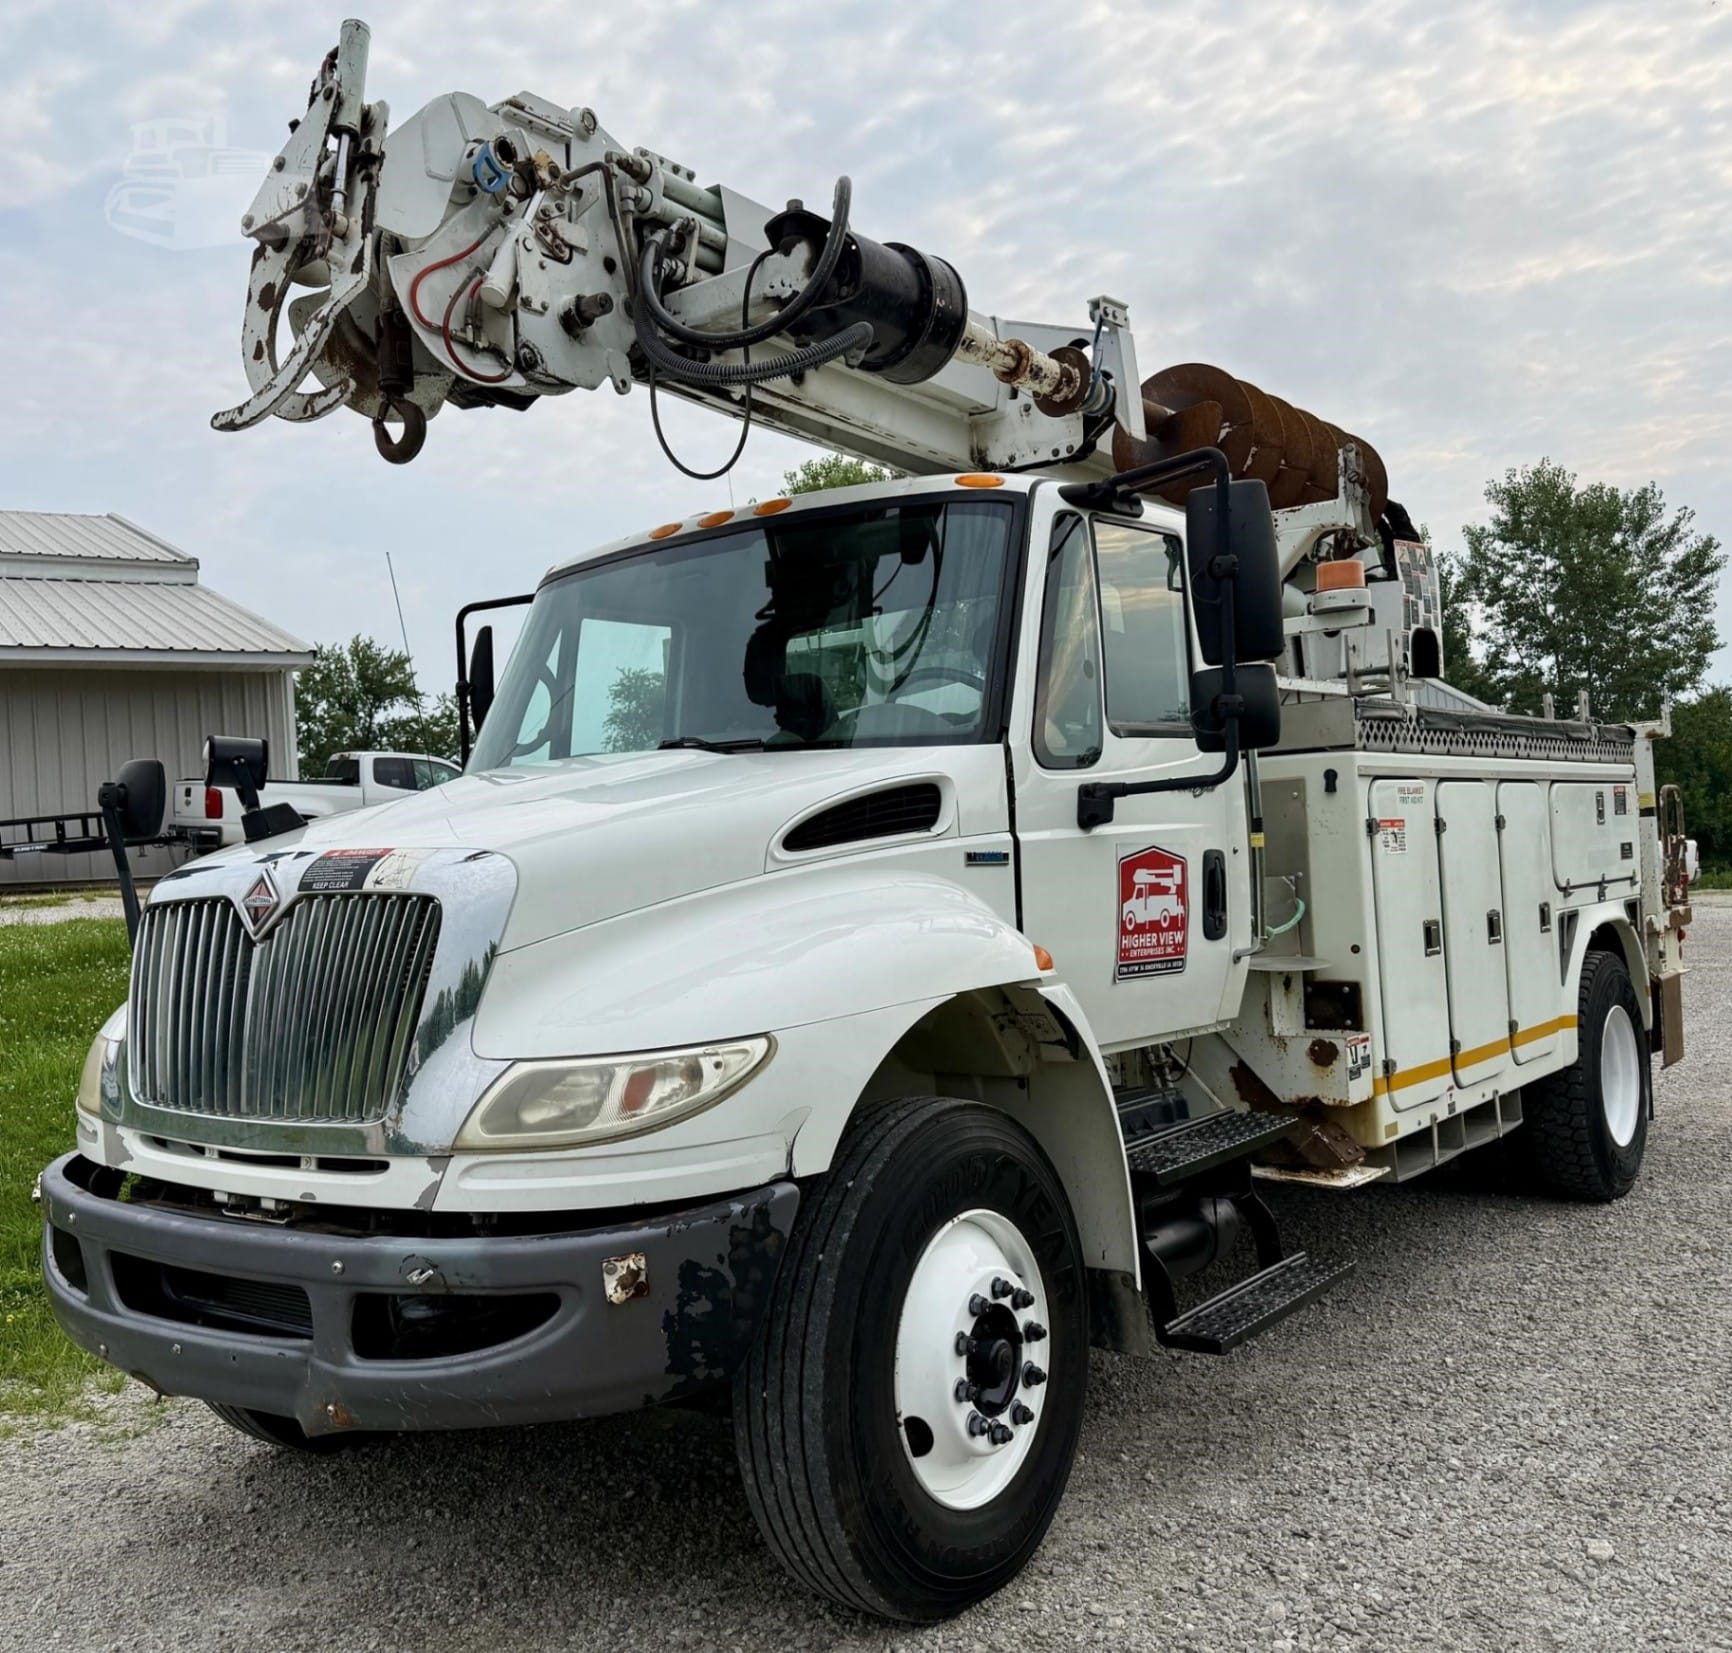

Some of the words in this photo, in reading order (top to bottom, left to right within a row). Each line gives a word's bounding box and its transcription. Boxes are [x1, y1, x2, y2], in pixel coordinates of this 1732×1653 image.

[312, 881, 328, 889] KEEP
[329, 881, 350, 889] CLEAR
[1121, 932, 1158, 949] HIGHER
[1159, 930, 1185, 945] VIEW
[1129, 946, 1165, 957] ENTERPRISES
